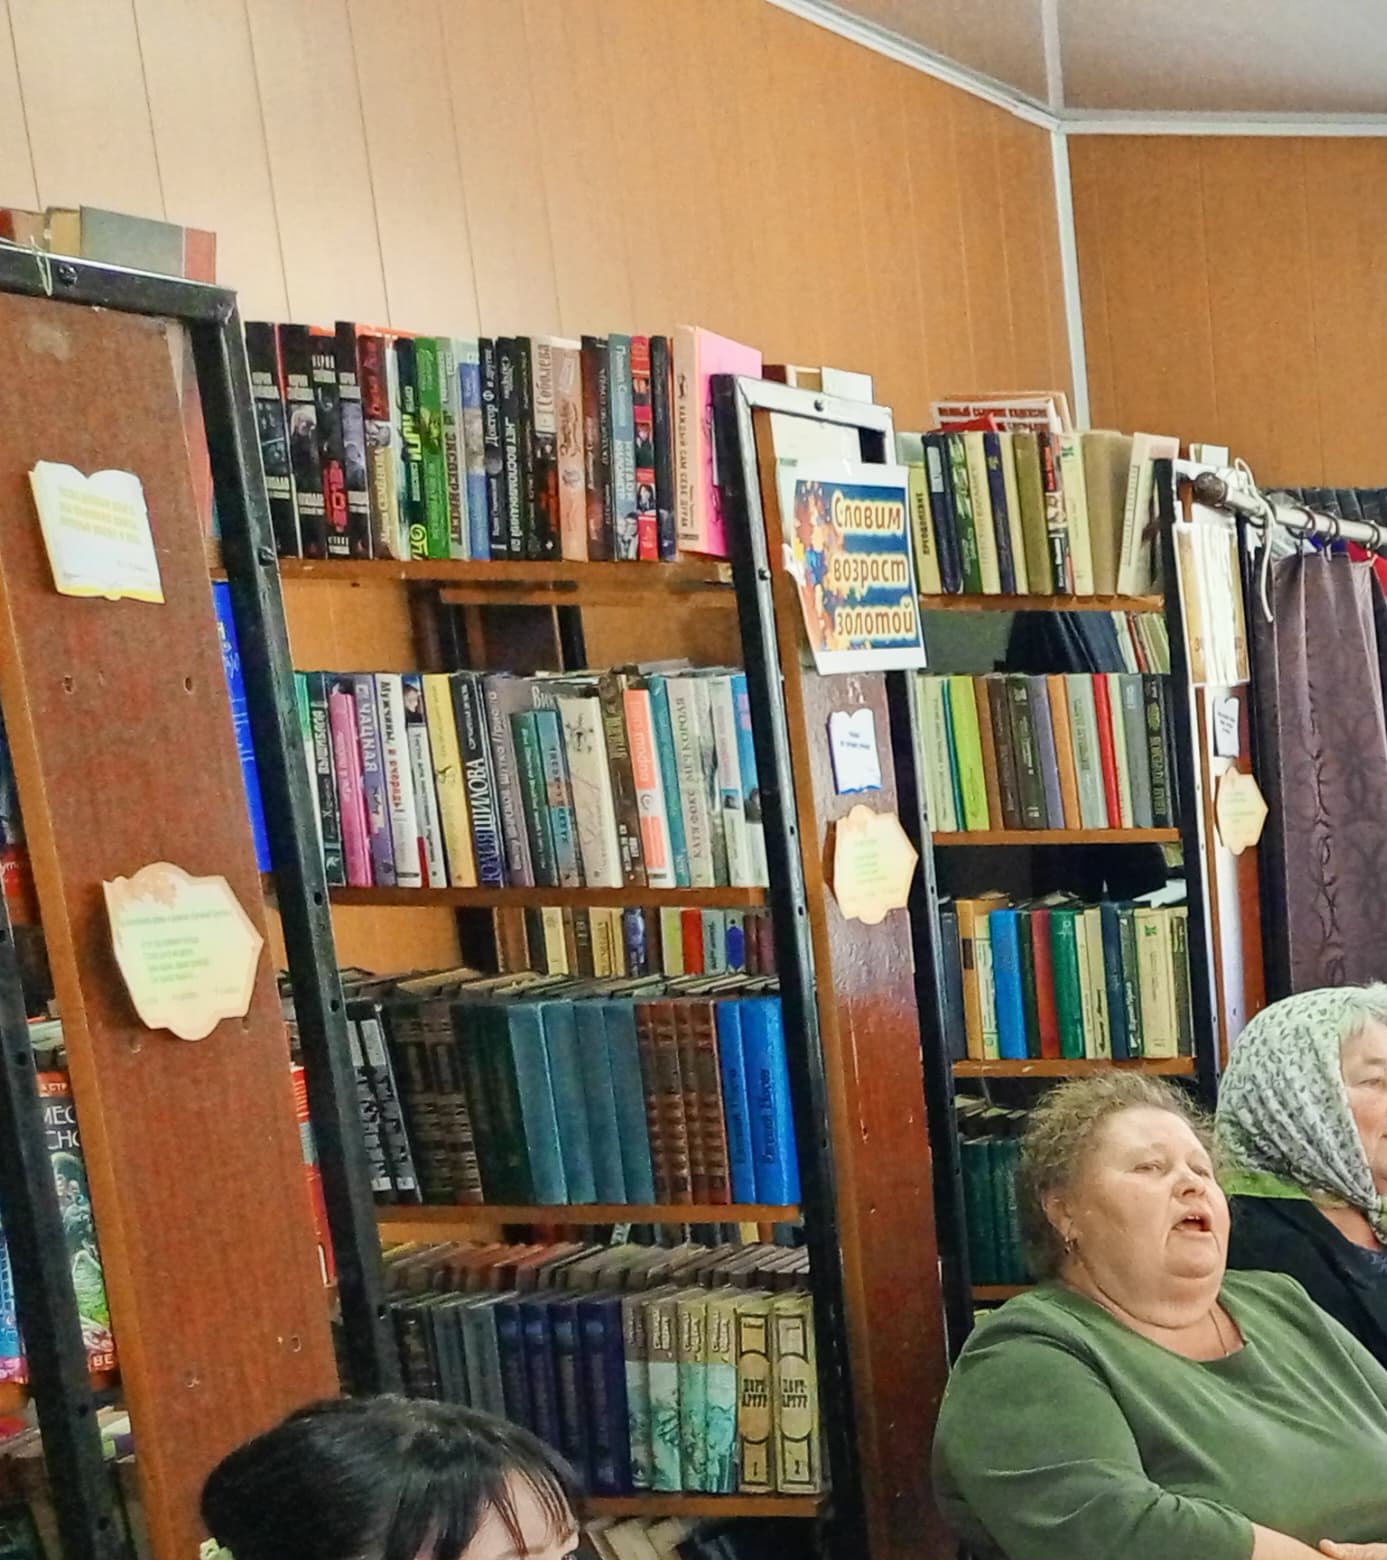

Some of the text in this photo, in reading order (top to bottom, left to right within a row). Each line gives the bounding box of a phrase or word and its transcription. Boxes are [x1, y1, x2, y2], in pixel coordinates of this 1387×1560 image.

[486, 404, 499, 446] Доктор
[679, 405, 688, 528] КАЖДЫЙ САМ СЕБЕ ДУРАК
[445, 431, 462, 547] ЭКСПЕРИМЕНТ
[834, 496, 901, 530] Славим
[833, 558, 906, 589] возраст
[837, 601, 914, 635] золотой
[380, 680, 396, 745] Мужчины,
[675, 696, 691, 752] КОРОЛЯ
[465, 757, 493, 832] ШИЛОВА
[687, 790, 700, 824] ФОКС
[690, 824, 703, 859] КАТЯ
